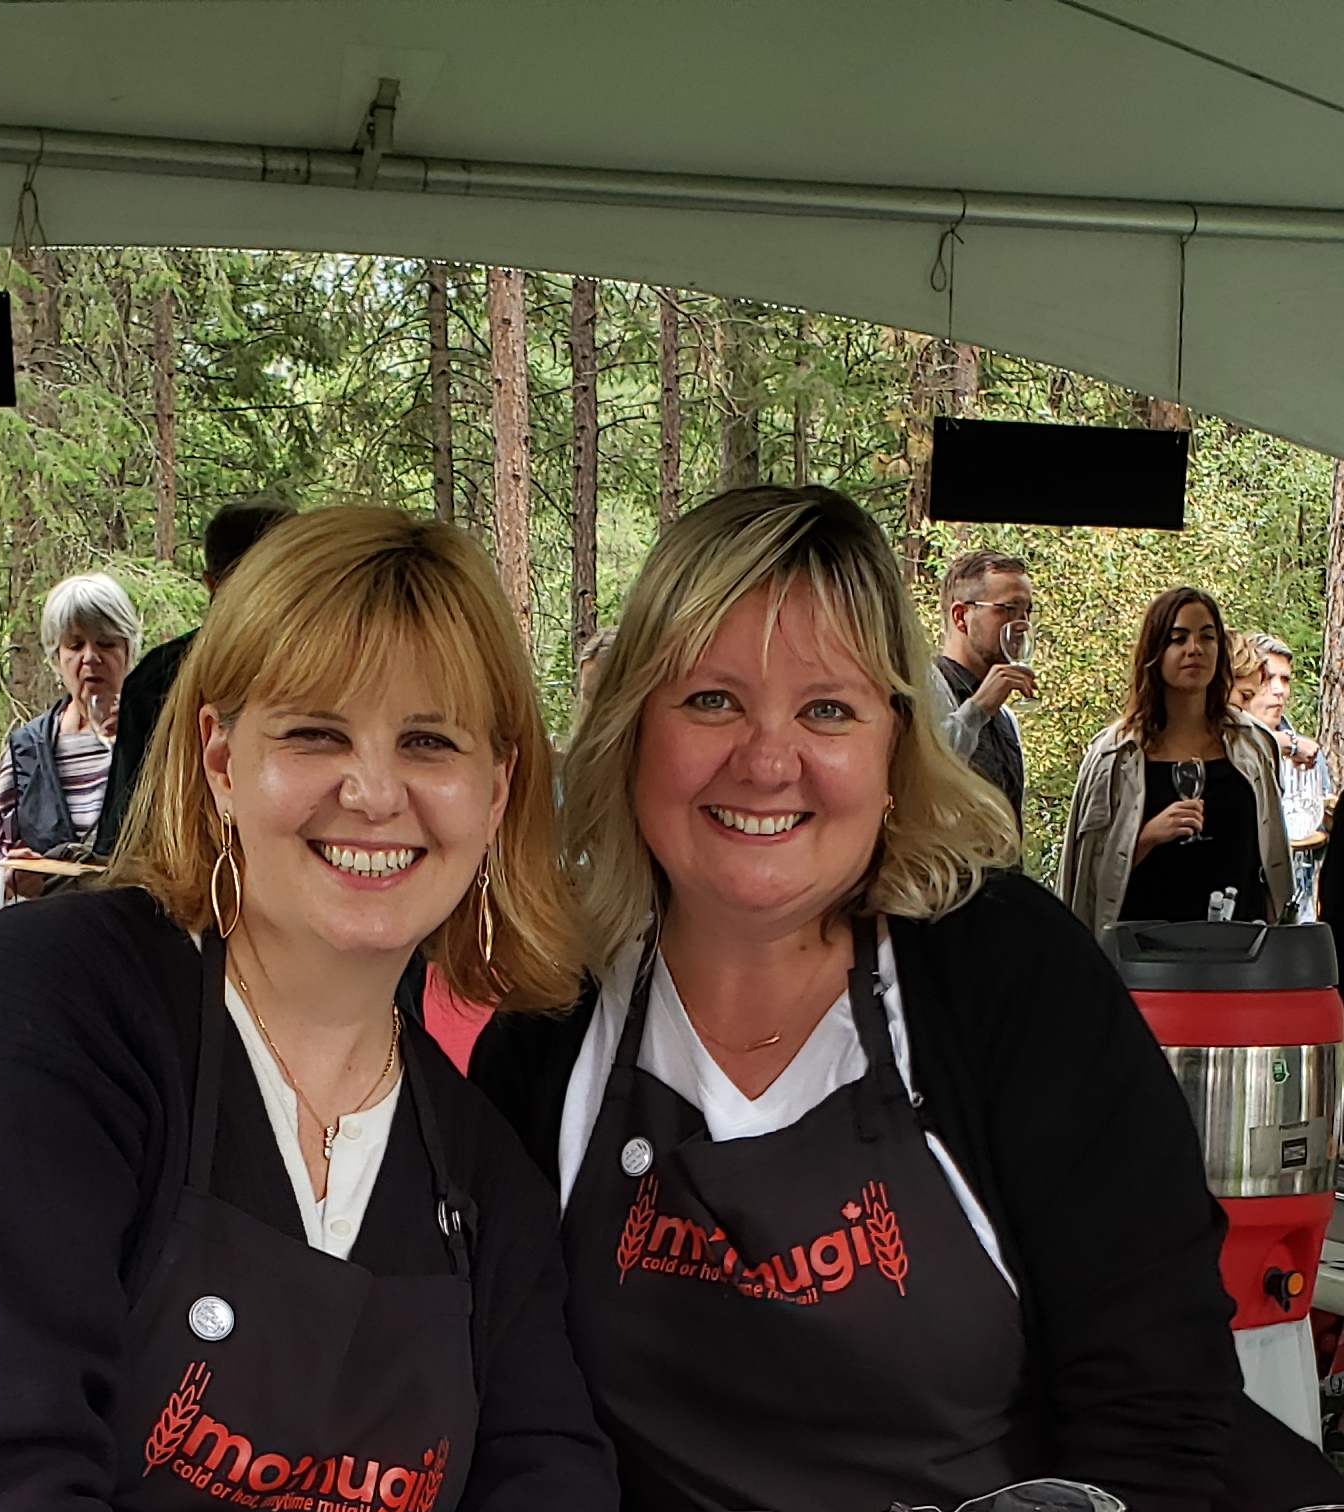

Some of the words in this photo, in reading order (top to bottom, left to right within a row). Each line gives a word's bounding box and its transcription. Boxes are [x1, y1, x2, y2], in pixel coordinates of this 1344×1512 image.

[641, 1256, 675, 1274] cold
[679, 1262, 698, 1278] or
[172, 1457, 208, 1490] cold
[210, 1481, 233, 1500] or
